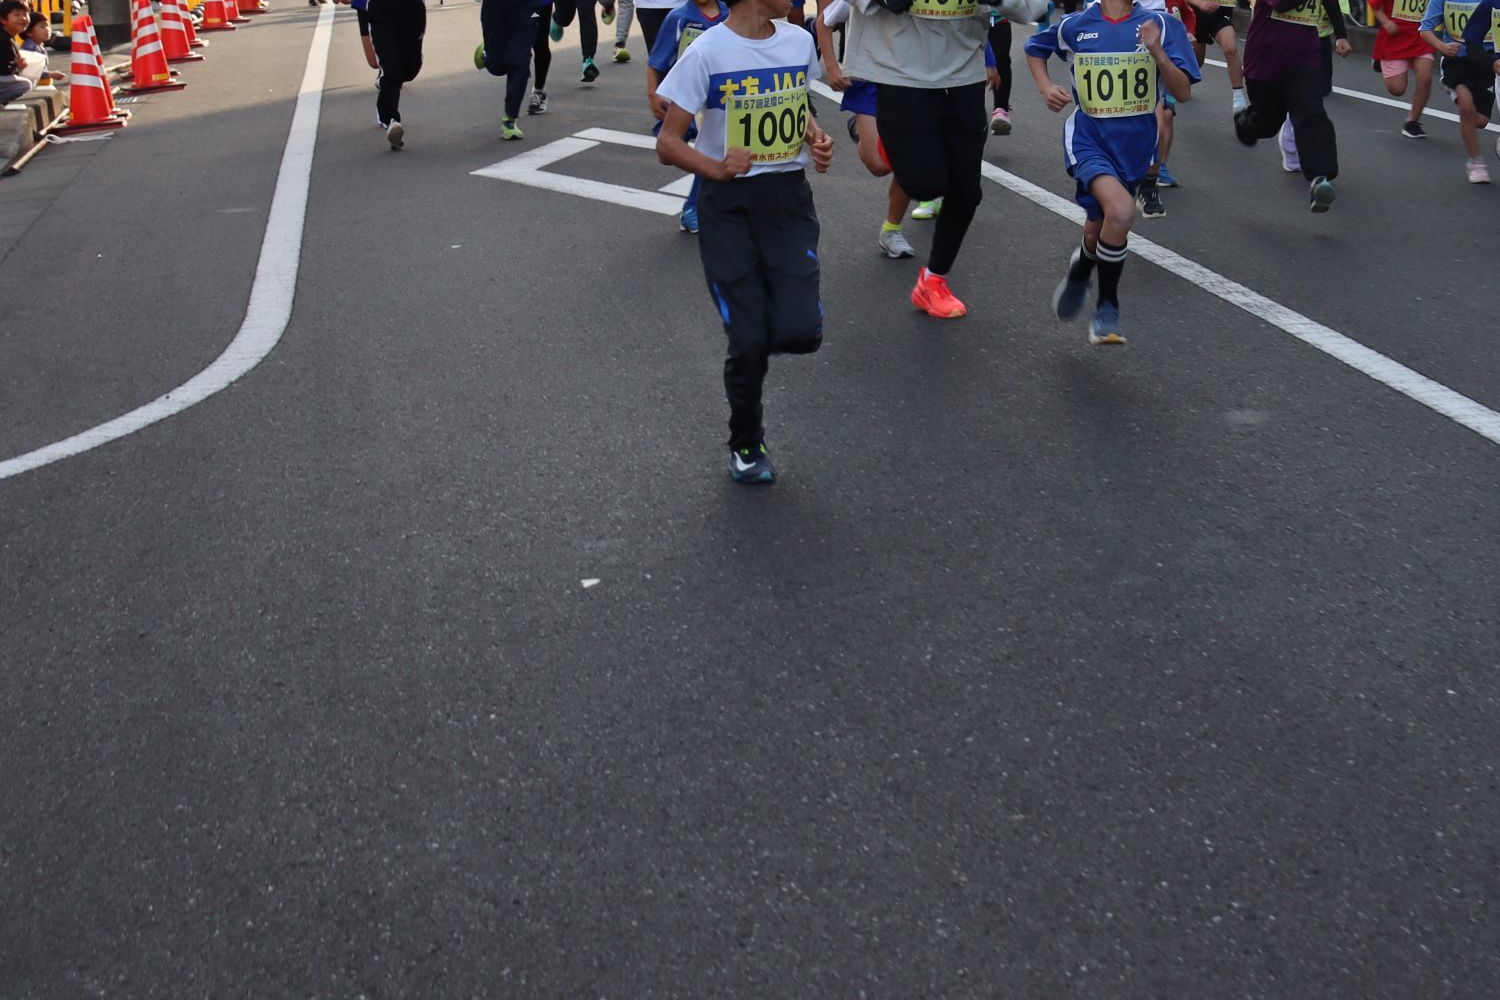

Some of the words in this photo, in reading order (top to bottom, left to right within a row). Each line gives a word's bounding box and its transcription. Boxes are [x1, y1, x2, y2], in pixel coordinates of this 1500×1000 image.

[1449, 12, 1467, 32] 10
[1083, 68, 1149, 101] 1018
[734, 93, 806, 111] 第57回足摺ロードレー
[739, 103, 806, 147] 1006
